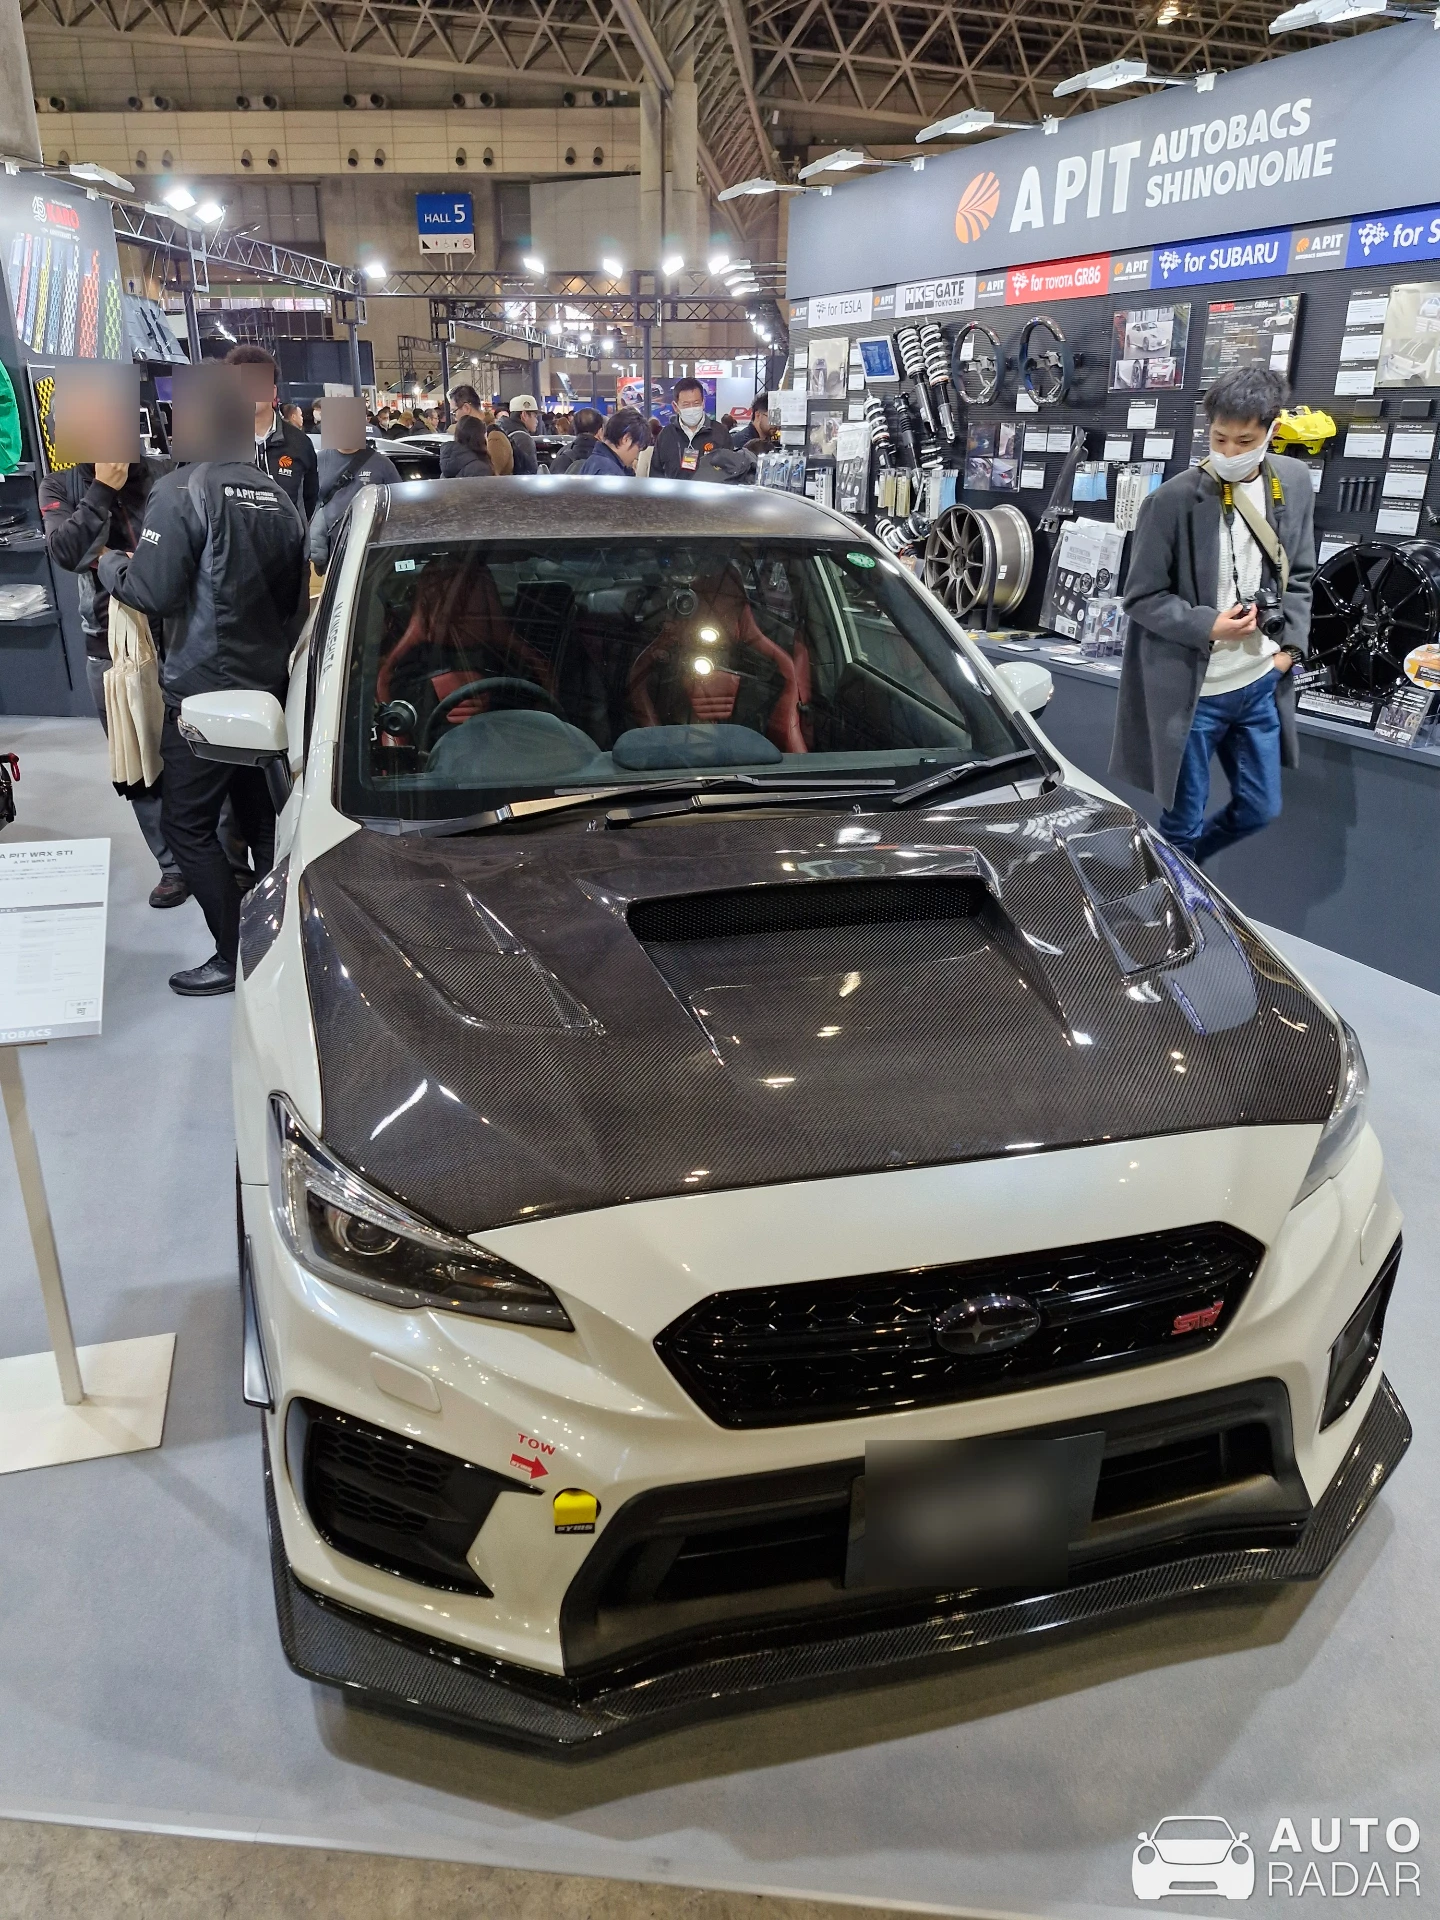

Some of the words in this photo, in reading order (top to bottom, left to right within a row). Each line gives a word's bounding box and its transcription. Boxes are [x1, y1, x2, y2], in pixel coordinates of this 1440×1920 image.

[1148, 98, 1312, 167] AUTOBACS
[1145, 138, 1337, 208] SHINONOME
[1008, 166, 1045, 233] A
[1052, 140, 1142, 225] PIT
[424, 213, 452, 223] HALL
[454, 204, 466, 223] 5
[1393, 223, 1425, 248] for
[1184, 252, 1207, 273] for
[1208, 241, 1280, 271] SUBARU
[1030, 274, 1044, 291] for
[1045, 274, 1073, 289] TOYOTA
[1074, 265, 1101, 286] GR86
[828, 302, 838, 316] for
[840, 299, 863, 315] TESLA
[905, 284, 935, 311] HKS
[935, 280, 965, 299] GATE
[935, 299, 952, 307] TOKYO
[953, 298, 964, 306] BAY
[1223, 484, 1232, 505] Nikon
[1272, 478, 1281, 499] Nikon
[517, 1432, 556, 1456] TOW
